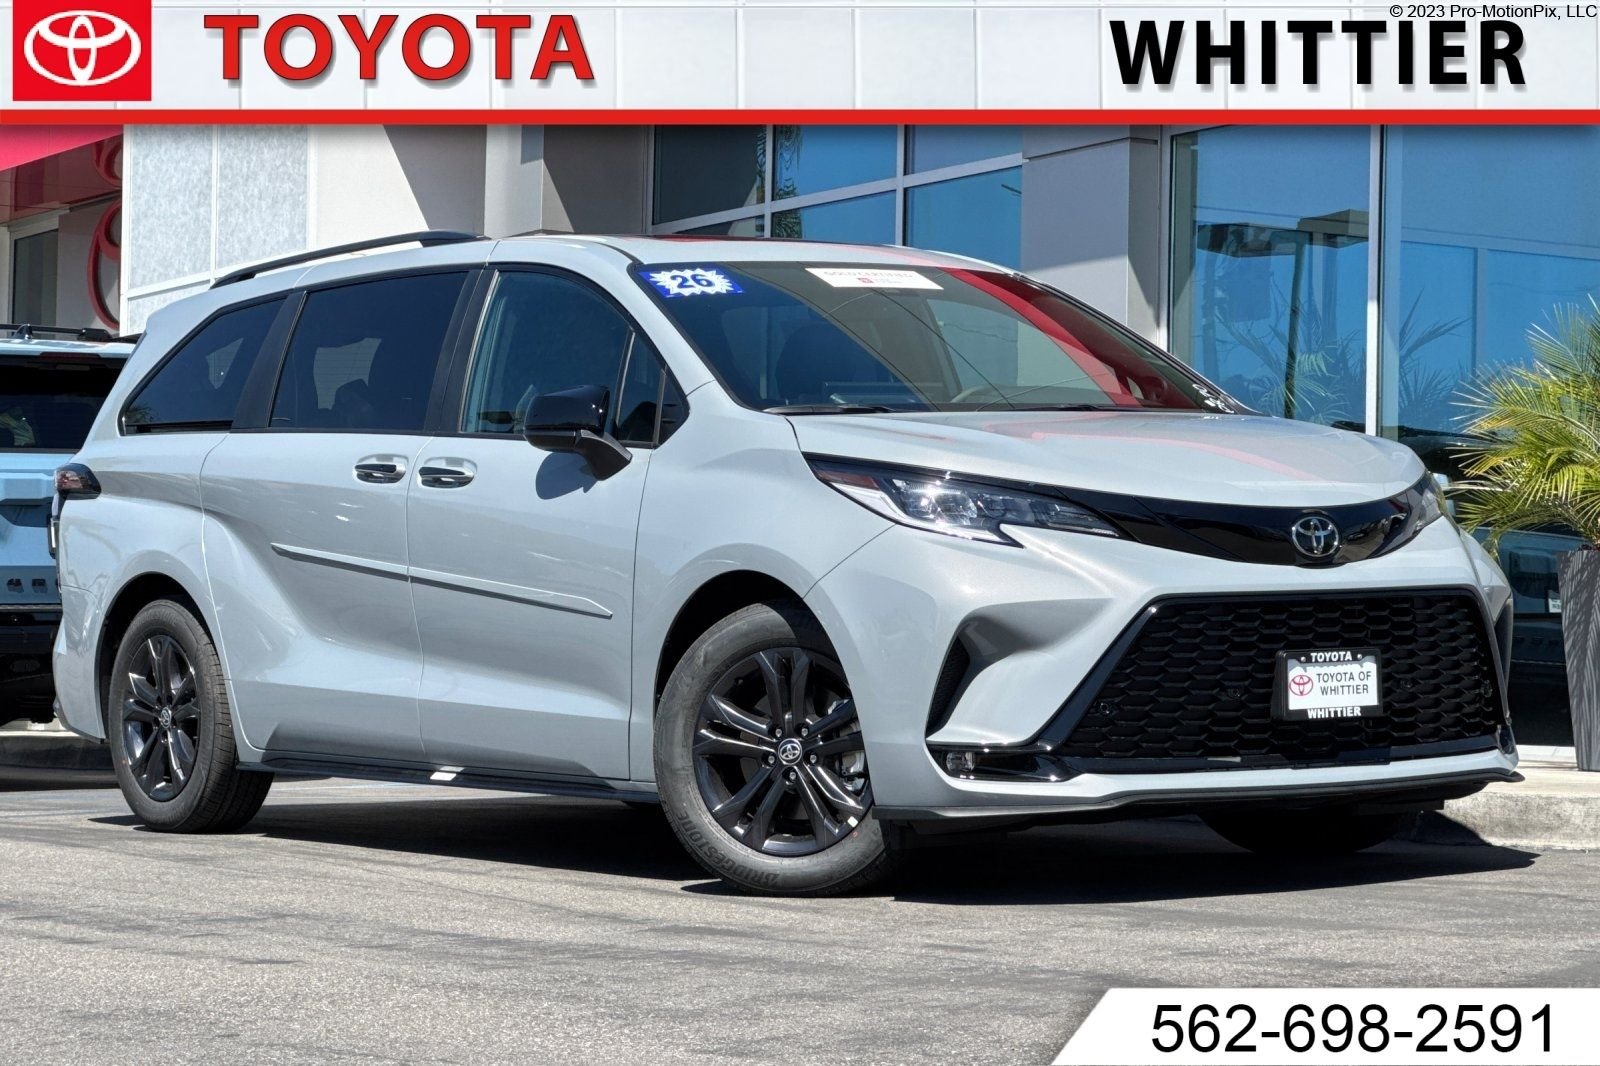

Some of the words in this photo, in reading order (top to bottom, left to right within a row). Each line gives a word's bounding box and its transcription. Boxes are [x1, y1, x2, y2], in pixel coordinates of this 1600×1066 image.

[670, 274, 715, 288] 26
[1310, 651, 1353, 662] TOYOTA
[1316, 672, 1354, 683] TOYOTA
[1358, 671, 1372, 682] OF
[1320, 684, 1369, 696] WHITTIER
[1307, 706, 1362, 719] WHITTIER
[677, 810, 780, 884] BRIDGESTONE
